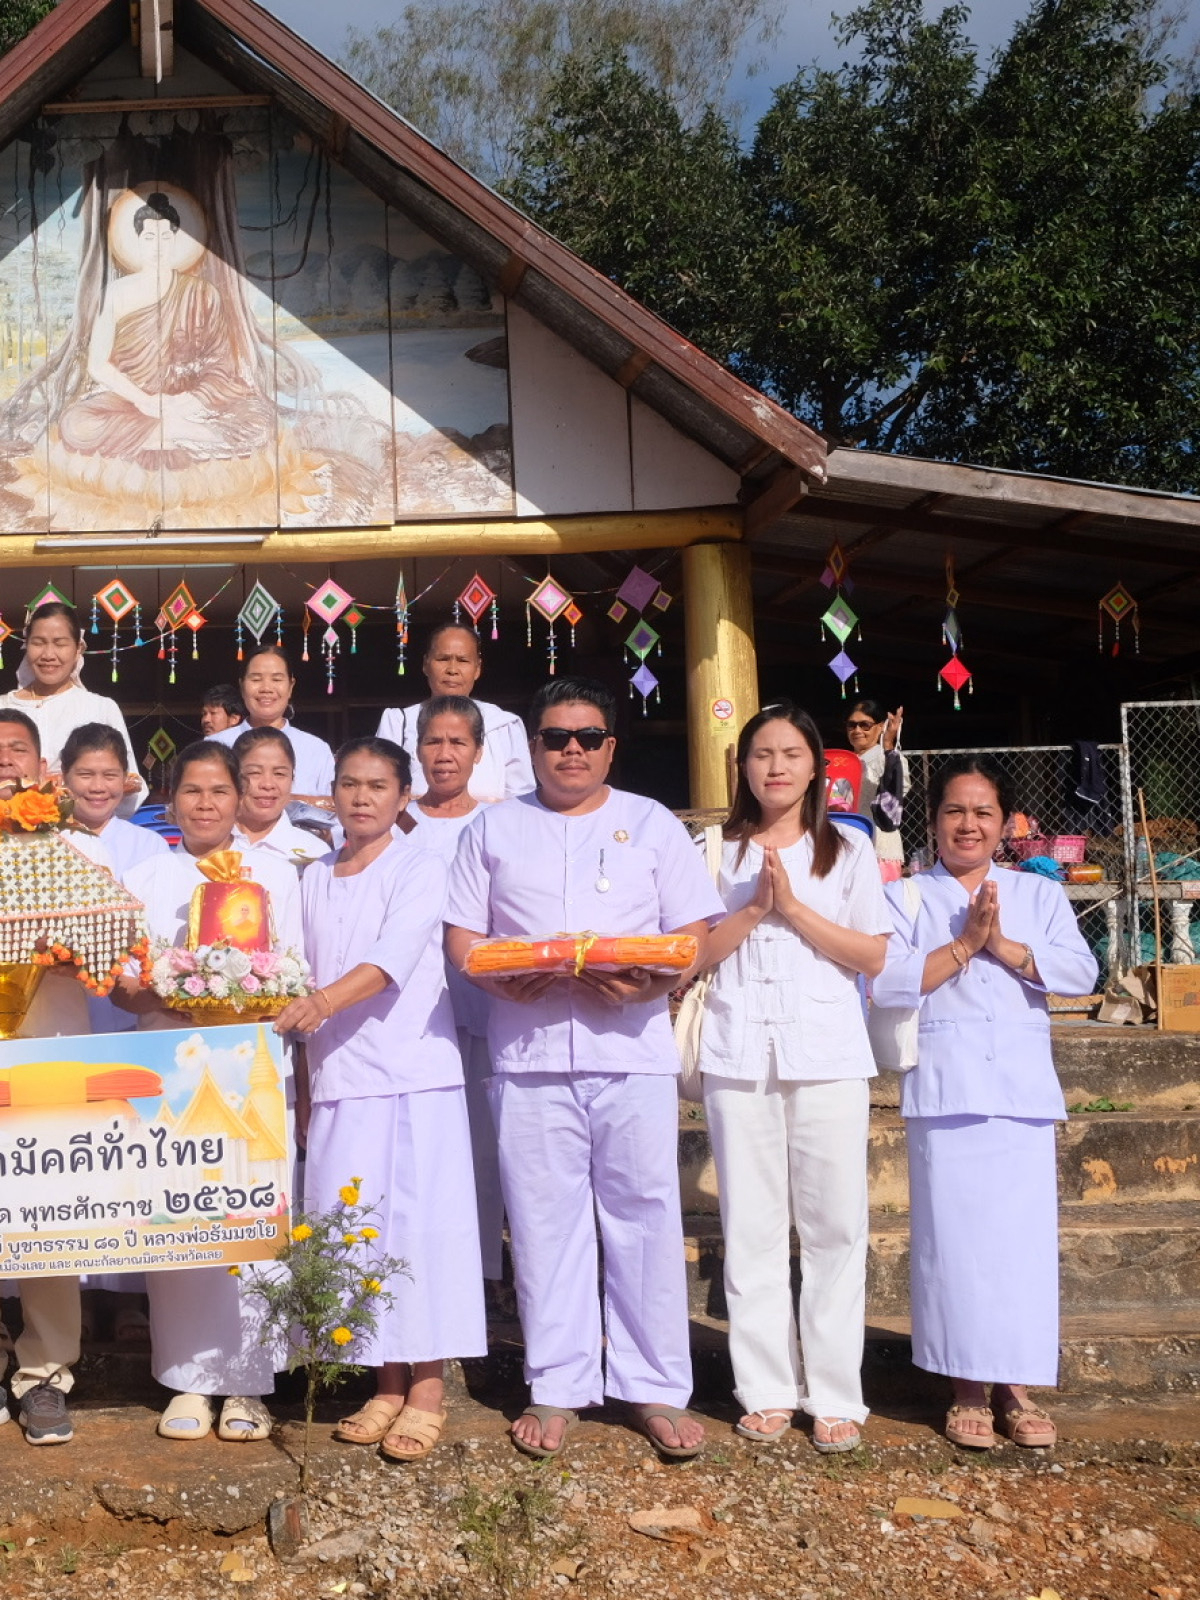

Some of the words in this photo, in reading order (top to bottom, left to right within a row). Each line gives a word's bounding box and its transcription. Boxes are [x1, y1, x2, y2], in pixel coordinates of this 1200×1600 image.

[20, 1196, 153, 1231] พุทธศักราช
[164, 1181, 275, 1214] ๒๕๖๘
[8, 1237, 89, 1260] บูชาธรรม
[94, 1236, 120, 1250] ๘๑
[124, 1229, 137, 1248] ปี
[143, 1220, 277, 1247] หลวงพ่อธัมมชโย
[49, 1259, 71, 1270] และ
[74, 1249, 223, 1268] คณะกัลยาณมิตรจังหวัดเลย
